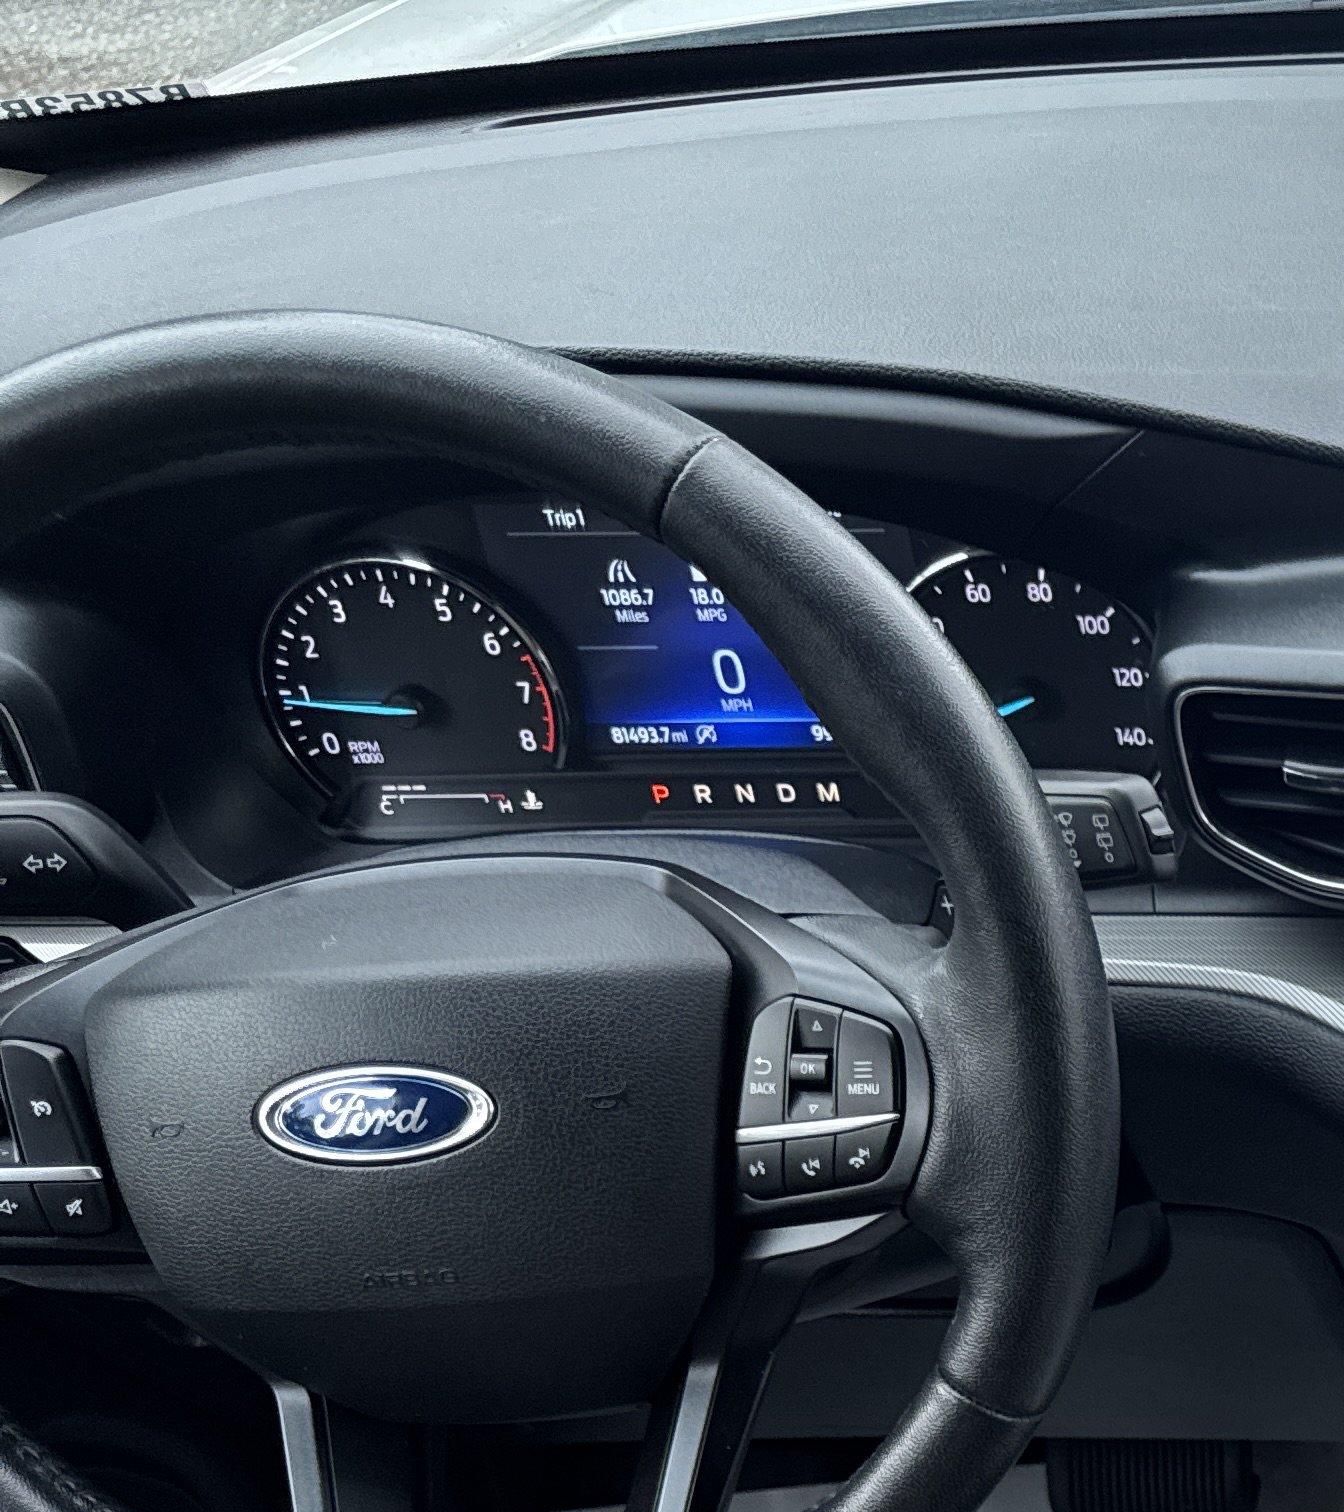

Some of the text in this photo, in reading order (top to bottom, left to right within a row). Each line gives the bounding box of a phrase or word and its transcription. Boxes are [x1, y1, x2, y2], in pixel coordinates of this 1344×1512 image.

[379, 585, 395, 609] 4
[600, 587, 725, 606] 1086.7 18.0
[965, 583, 991, 603] 60
[1026, 582, 1052, 603] 80
[328, 600, 347, 623] 3
[434, 598, 452, 622] 5
[615, 608, 728, 624] Miles MPG
[1075, 614, 1110, 635] 100
[300, 635, 320, 659] 2
[483, 632, 501, 656] 6
[712, 648, 747, 696] 0
[1112, 667, 1144, 688] 120
[515, 681, 530, 704] 7
[721, 698, 754, 713] MPH
[321, 732, 340, 754] 0
[518, 729, 537, 752] 8
[610, 726, 670, 744] 81493.7
[1114, 727, 1147, 747] 140
[348, 740, 380, 753] RPM
[652, 782, 841, 805] P R N D M
[800, 1063, 816, 1074] OK
[750, 1083, 776, 1095] BACK
[848, 1083, 880, 1095] MENU
[314, 1087, 429, 1139] Ford
